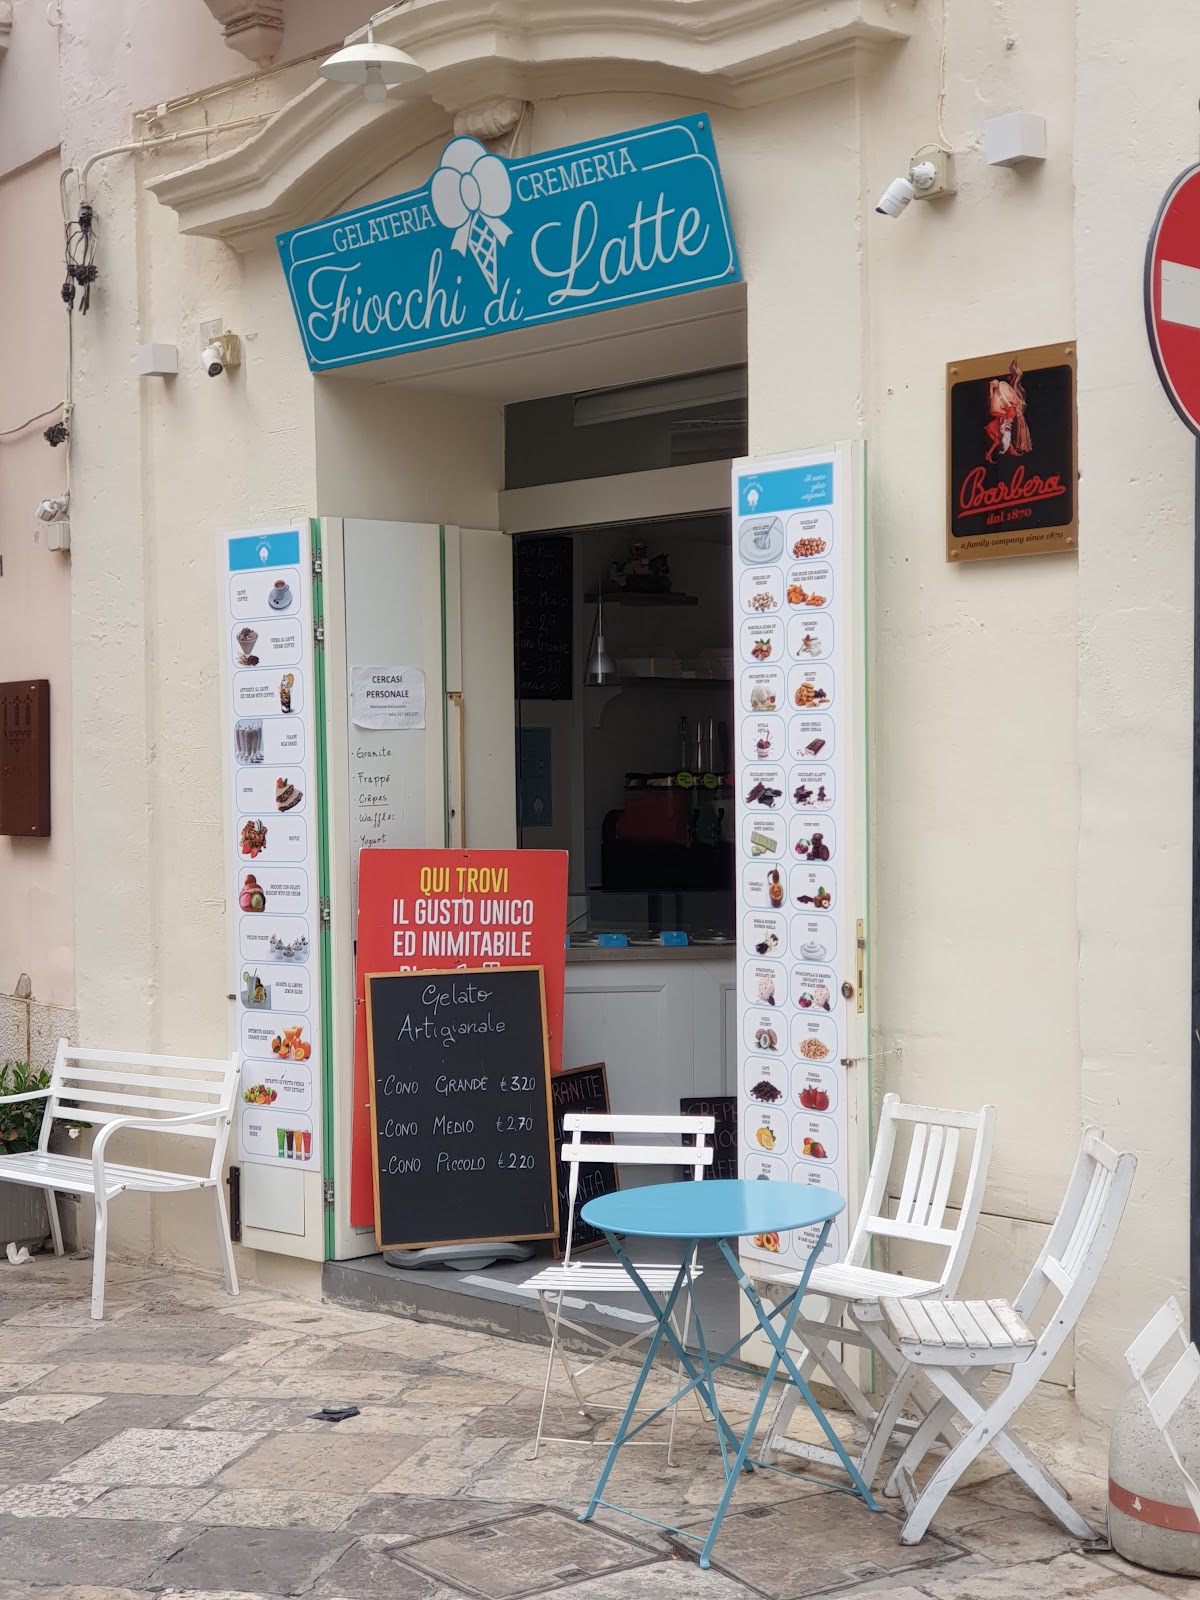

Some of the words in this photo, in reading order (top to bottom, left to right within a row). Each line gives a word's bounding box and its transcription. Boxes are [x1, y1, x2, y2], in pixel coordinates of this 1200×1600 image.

[516, 148, 637, 202] CREMERIA
[333, 204, 439, 254] GELATERIA
[308, 248, 466, 342] Fiocchi
[484, 279, 523, 327] di
[531, 192, 710, 307] Latte
[959, 465, 1065, 510] Barbera
[986, 513, 1004, 525] dal
[1007, 508, 1032, 521] 1870
[965, 538, 990, 550] family
[991, 536, 1024, 547] company
[1026, 533, 1044, 542] since
[1046, 532, 1064, 540] 1870
[372, 676, 403, 684] CERCASI
[366, 690, 409, 698] PERSONALE
[356, 747, 392, 759] Granite
[359, 794, 388, 804] Crêpes
[360, 834, 387, 848] Yogurt
[420, 866, 450, 896] QUI
[456, 868, 509, 894] TROVI
[392, 899, 410, 924] IL
[414, 898, 474, 925] GUSTO
[480, 900, 534, 926] UNICO
[394, 931, 416, 957] ED
[422, 931, 532, 957] INIMITABILE
[422, 983, 493, 1015] Gelato
[397, 1012, 506, 1048] Artigianale
[384, 1075, 419, 1096] CONO
[552, 1075, 602, 1106] RANITE
[384, 1118, 418, 1138] CONO
[432, 1115, 474, 1136] MEDIO
[388, 1155, 422, 1174] CONO
[560, 1170, 605, 1212] MNTA
